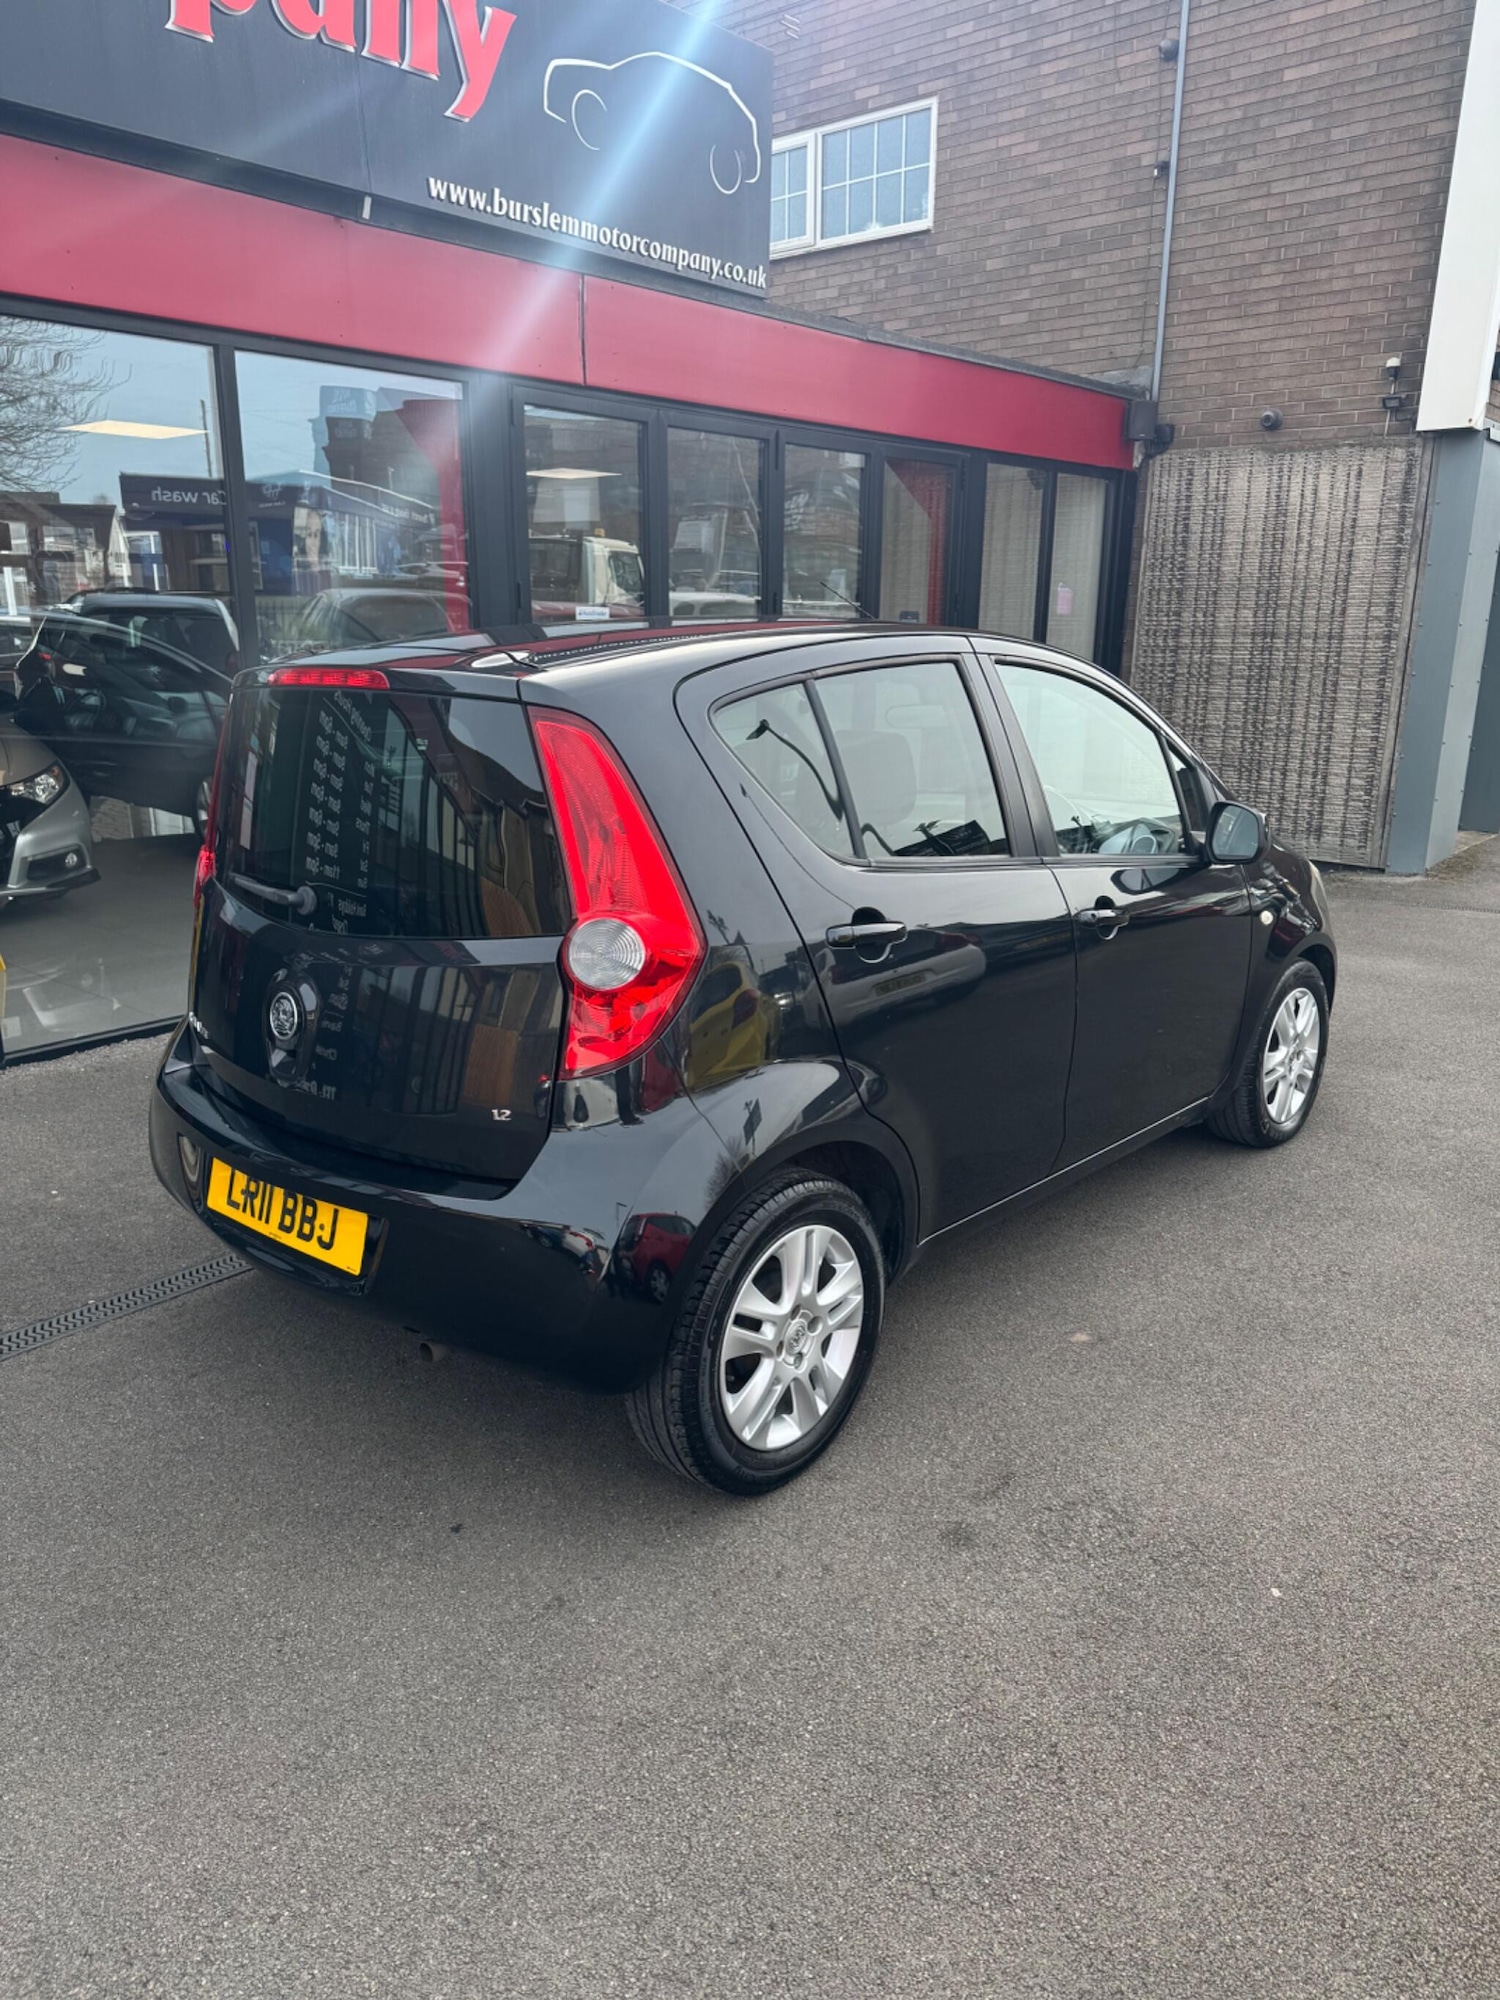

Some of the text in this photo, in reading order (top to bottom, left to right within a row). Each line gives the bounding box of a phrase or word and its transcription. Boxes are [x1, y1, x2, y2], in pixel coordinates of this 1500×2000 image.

[426, 176, 767, 289] www.burslemmotorcompany.co.uk
[226, 1168, 341, 1251] LR11 BBJ
